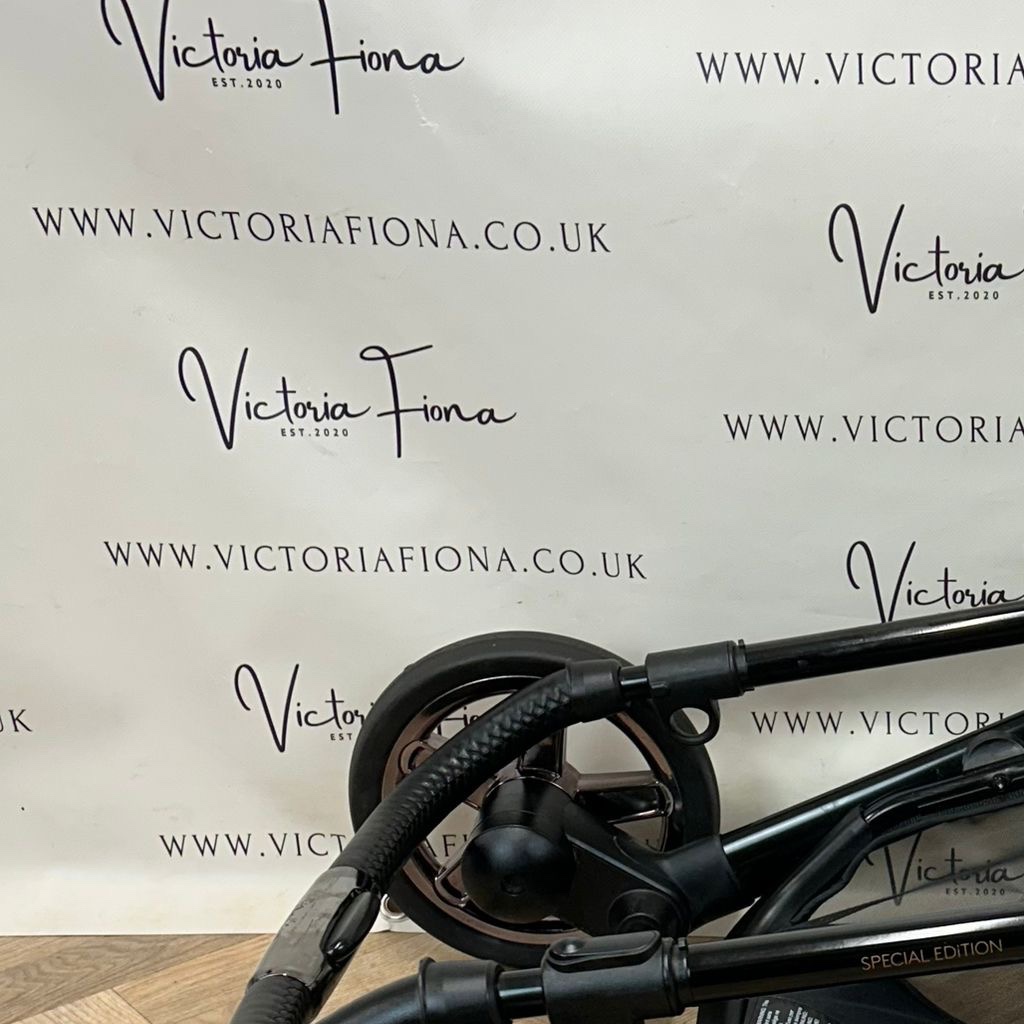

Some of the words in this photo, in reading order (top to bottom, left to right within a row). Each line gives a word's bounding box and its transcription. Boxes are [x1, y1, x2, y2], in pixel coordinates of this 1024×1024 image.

[100, 0, 303, 101] Victoria
[309, 0, 464, 115] Fiona
[211, 76, 282, 89] EST.2020
[32, 207, 611, 252] WWW.VICTORIAFIONA.CO.UK
[928, 290, 999, 301] EST.2020
[178, 346, 371, 450] Victoria
[360, 345, 517, 458] Fiona
[280, 427, 349, 438] EST.2020
[104, 541, 647, 579] WWW.VICTORIAFIONA.CO.UK
[234, 664, 372, 753] Victor
[861, 950, 930, 971] SPECIAL
